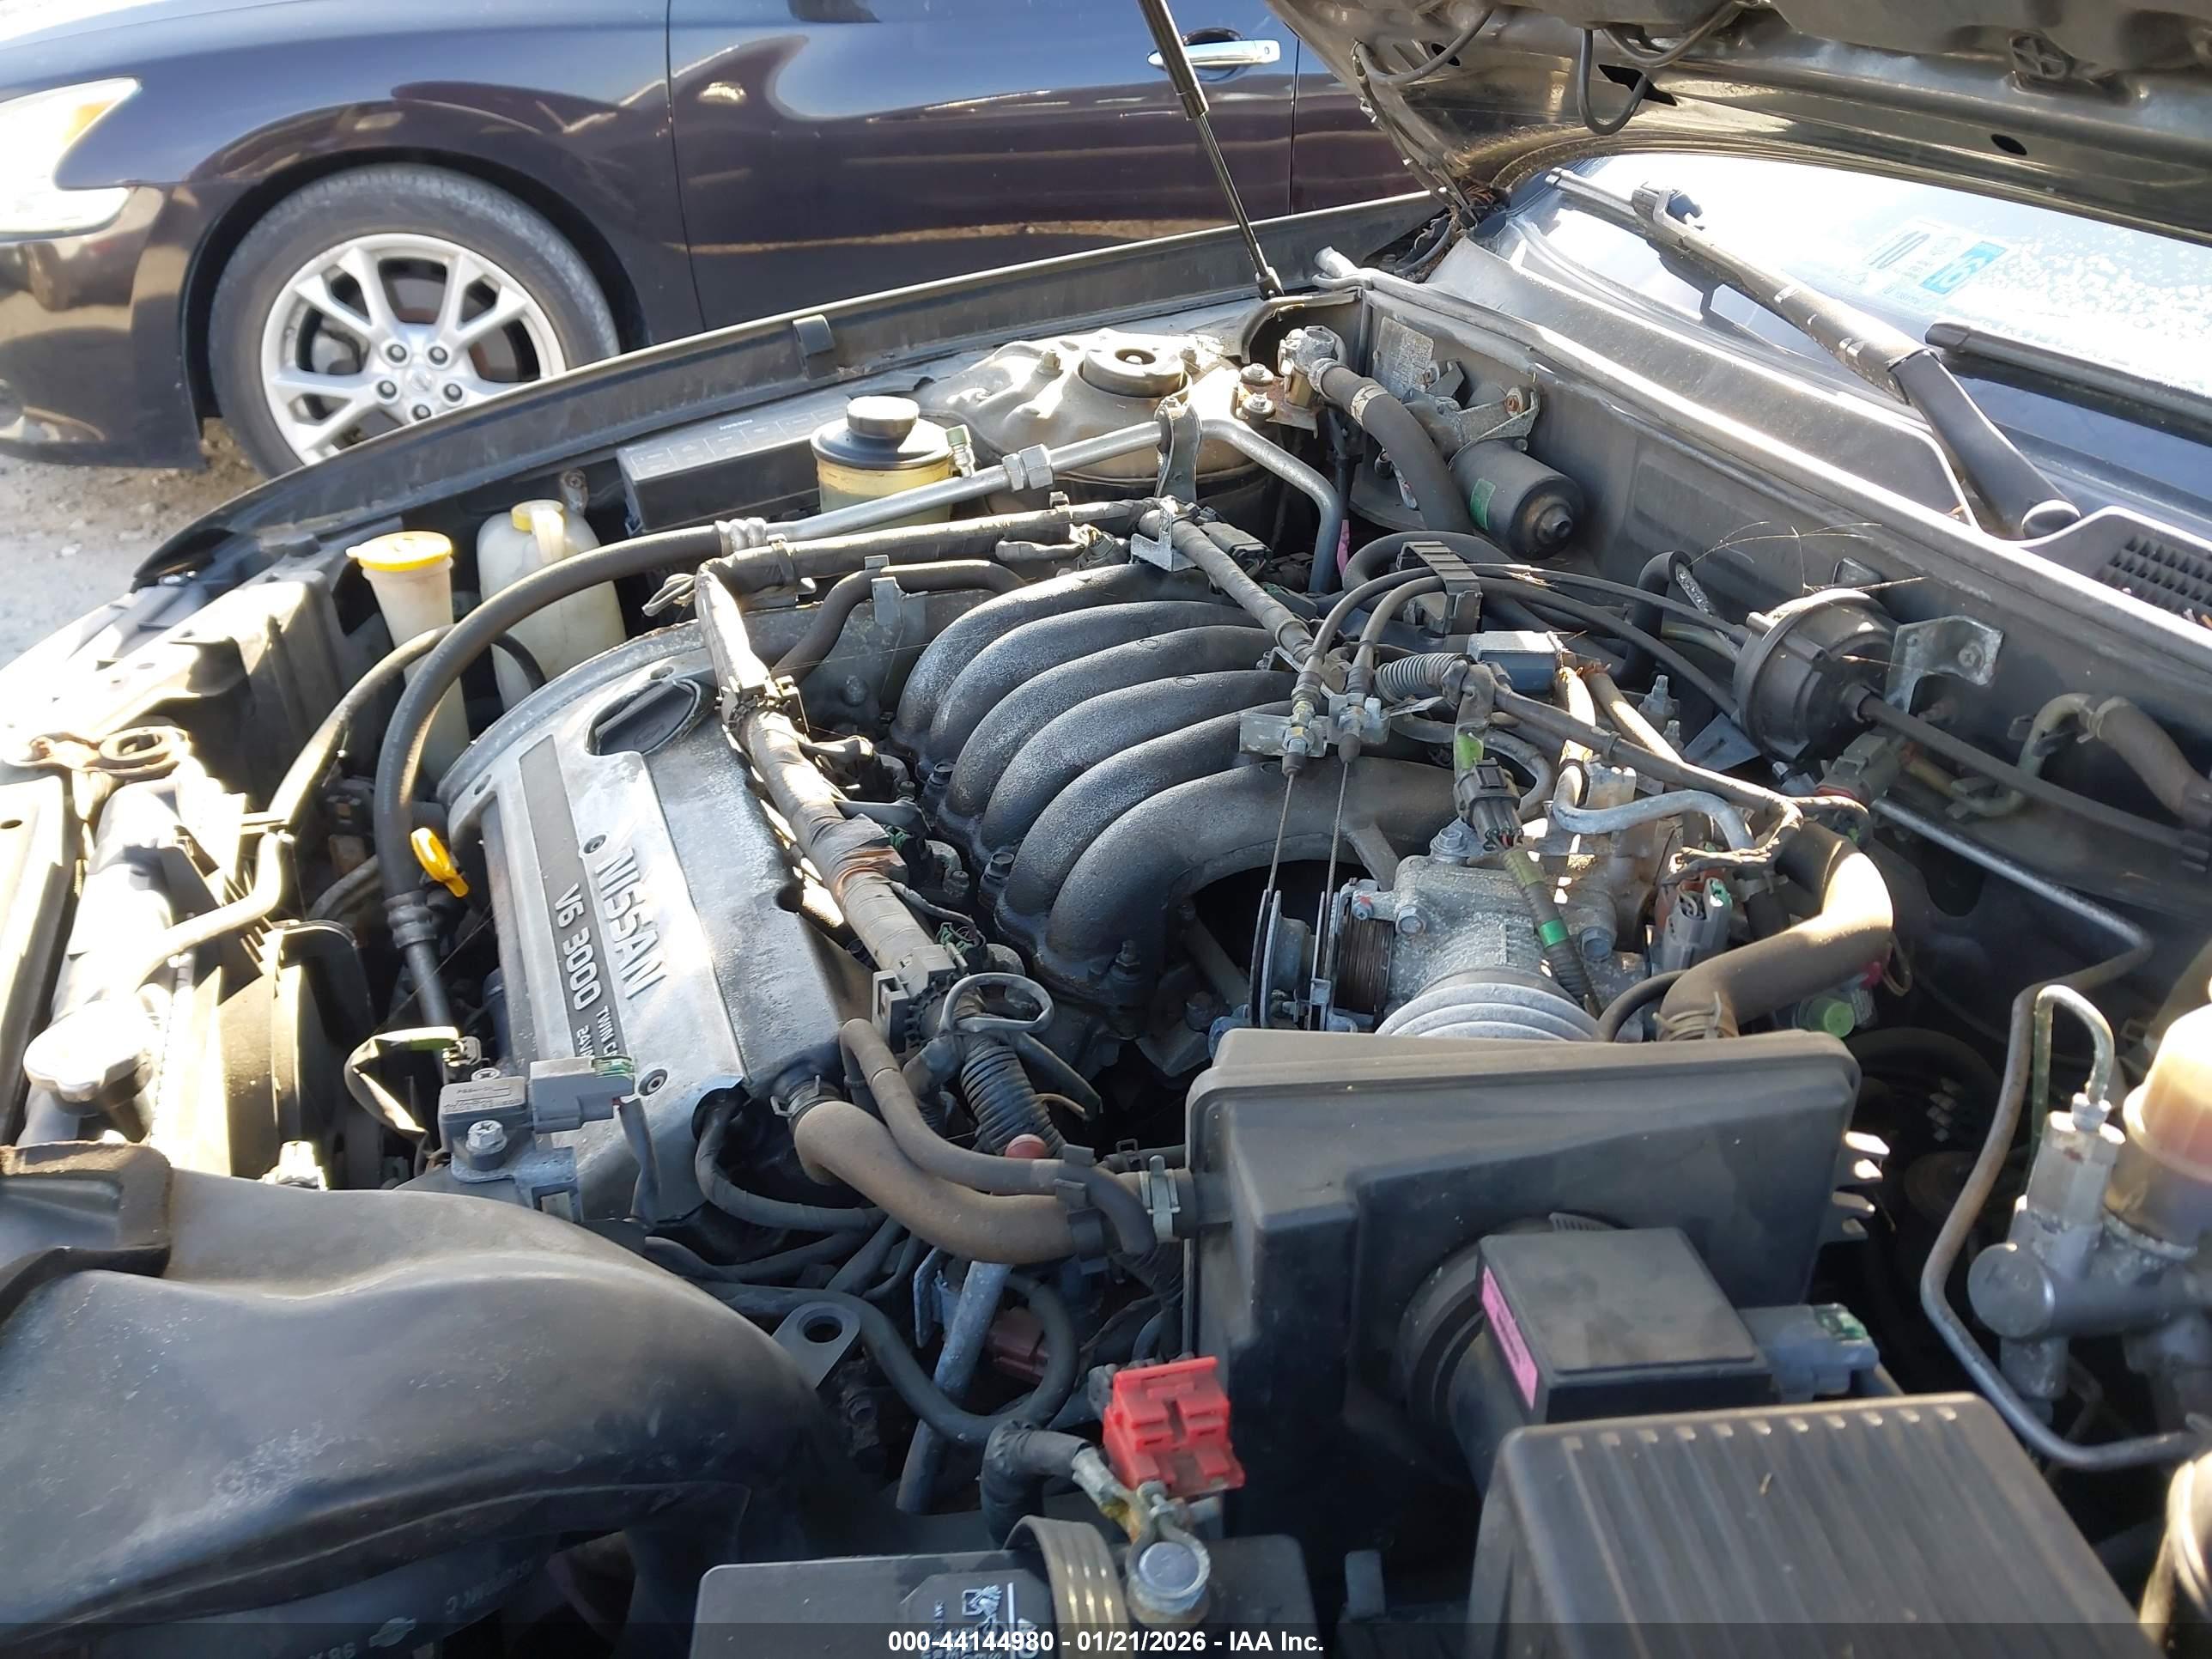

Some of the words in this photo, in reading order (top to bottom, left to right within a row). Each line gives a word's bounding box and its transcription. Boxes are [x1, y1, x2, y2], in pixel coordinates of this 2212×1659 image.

[555, 883, 585, 928] V6
[594, 847, 667, 1000] NISSAN
[562, 927, 602, 1011] 3000
[595, 1005, 615, 1042] TWIN
